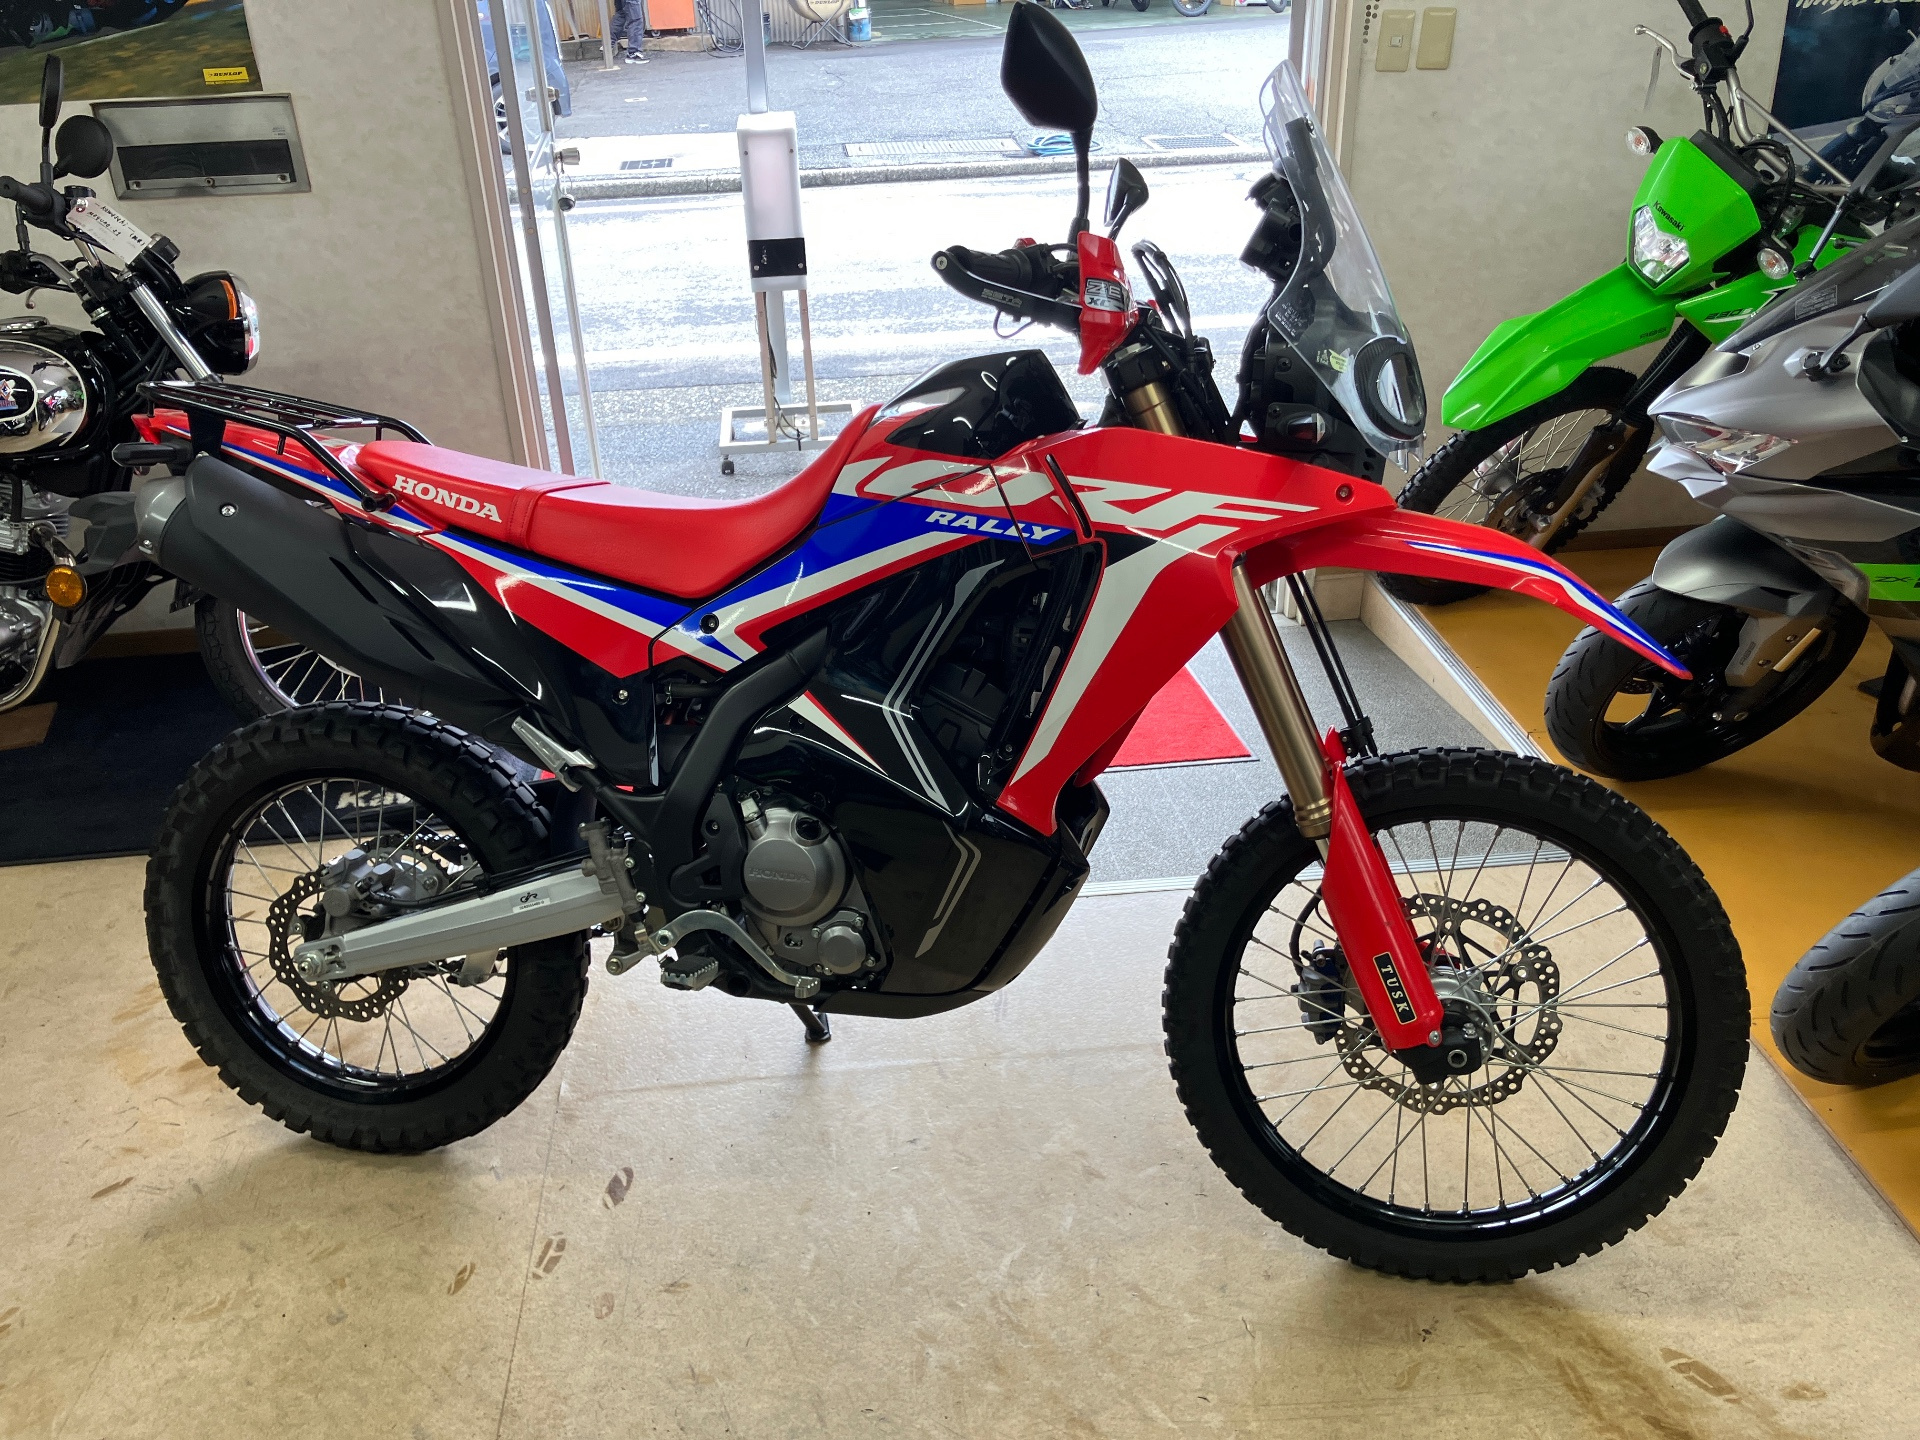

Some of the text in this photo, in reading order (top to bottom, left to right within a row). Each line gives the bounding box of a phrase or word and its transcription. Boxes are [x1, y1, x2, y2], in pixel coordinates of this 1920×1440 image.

[1653, 200, 1686, 232] Kawasaki
[392, 474, 503, 524] HONDA
[862, 458, 1320, 532] CRF
[924, 510, 1061, 541] RALLY
[748, 866, 812, 884] HONDA
[1381, 964, 1409, 1013] TUSK
